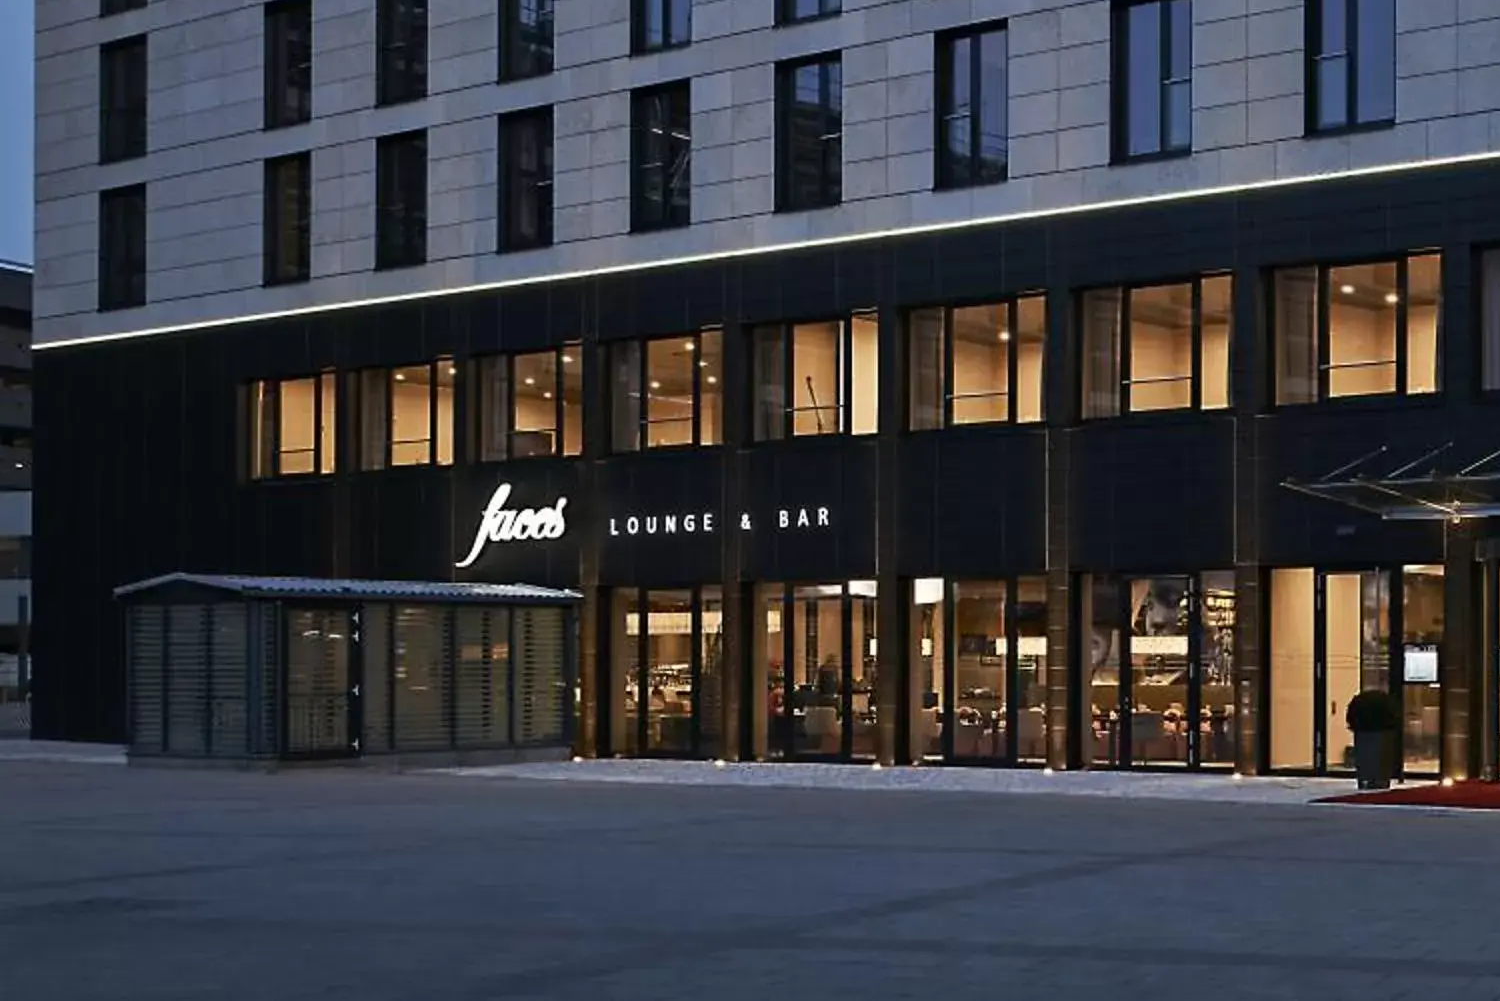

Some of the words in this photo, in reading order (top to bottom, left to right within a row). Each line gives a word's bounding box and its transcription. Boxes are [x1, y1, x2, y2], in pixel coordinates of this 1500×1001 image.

[609, 513, 714, 536] LOUNGE
[740, 513, 752, 530] &
[779, 506, 831, 529] BAR
